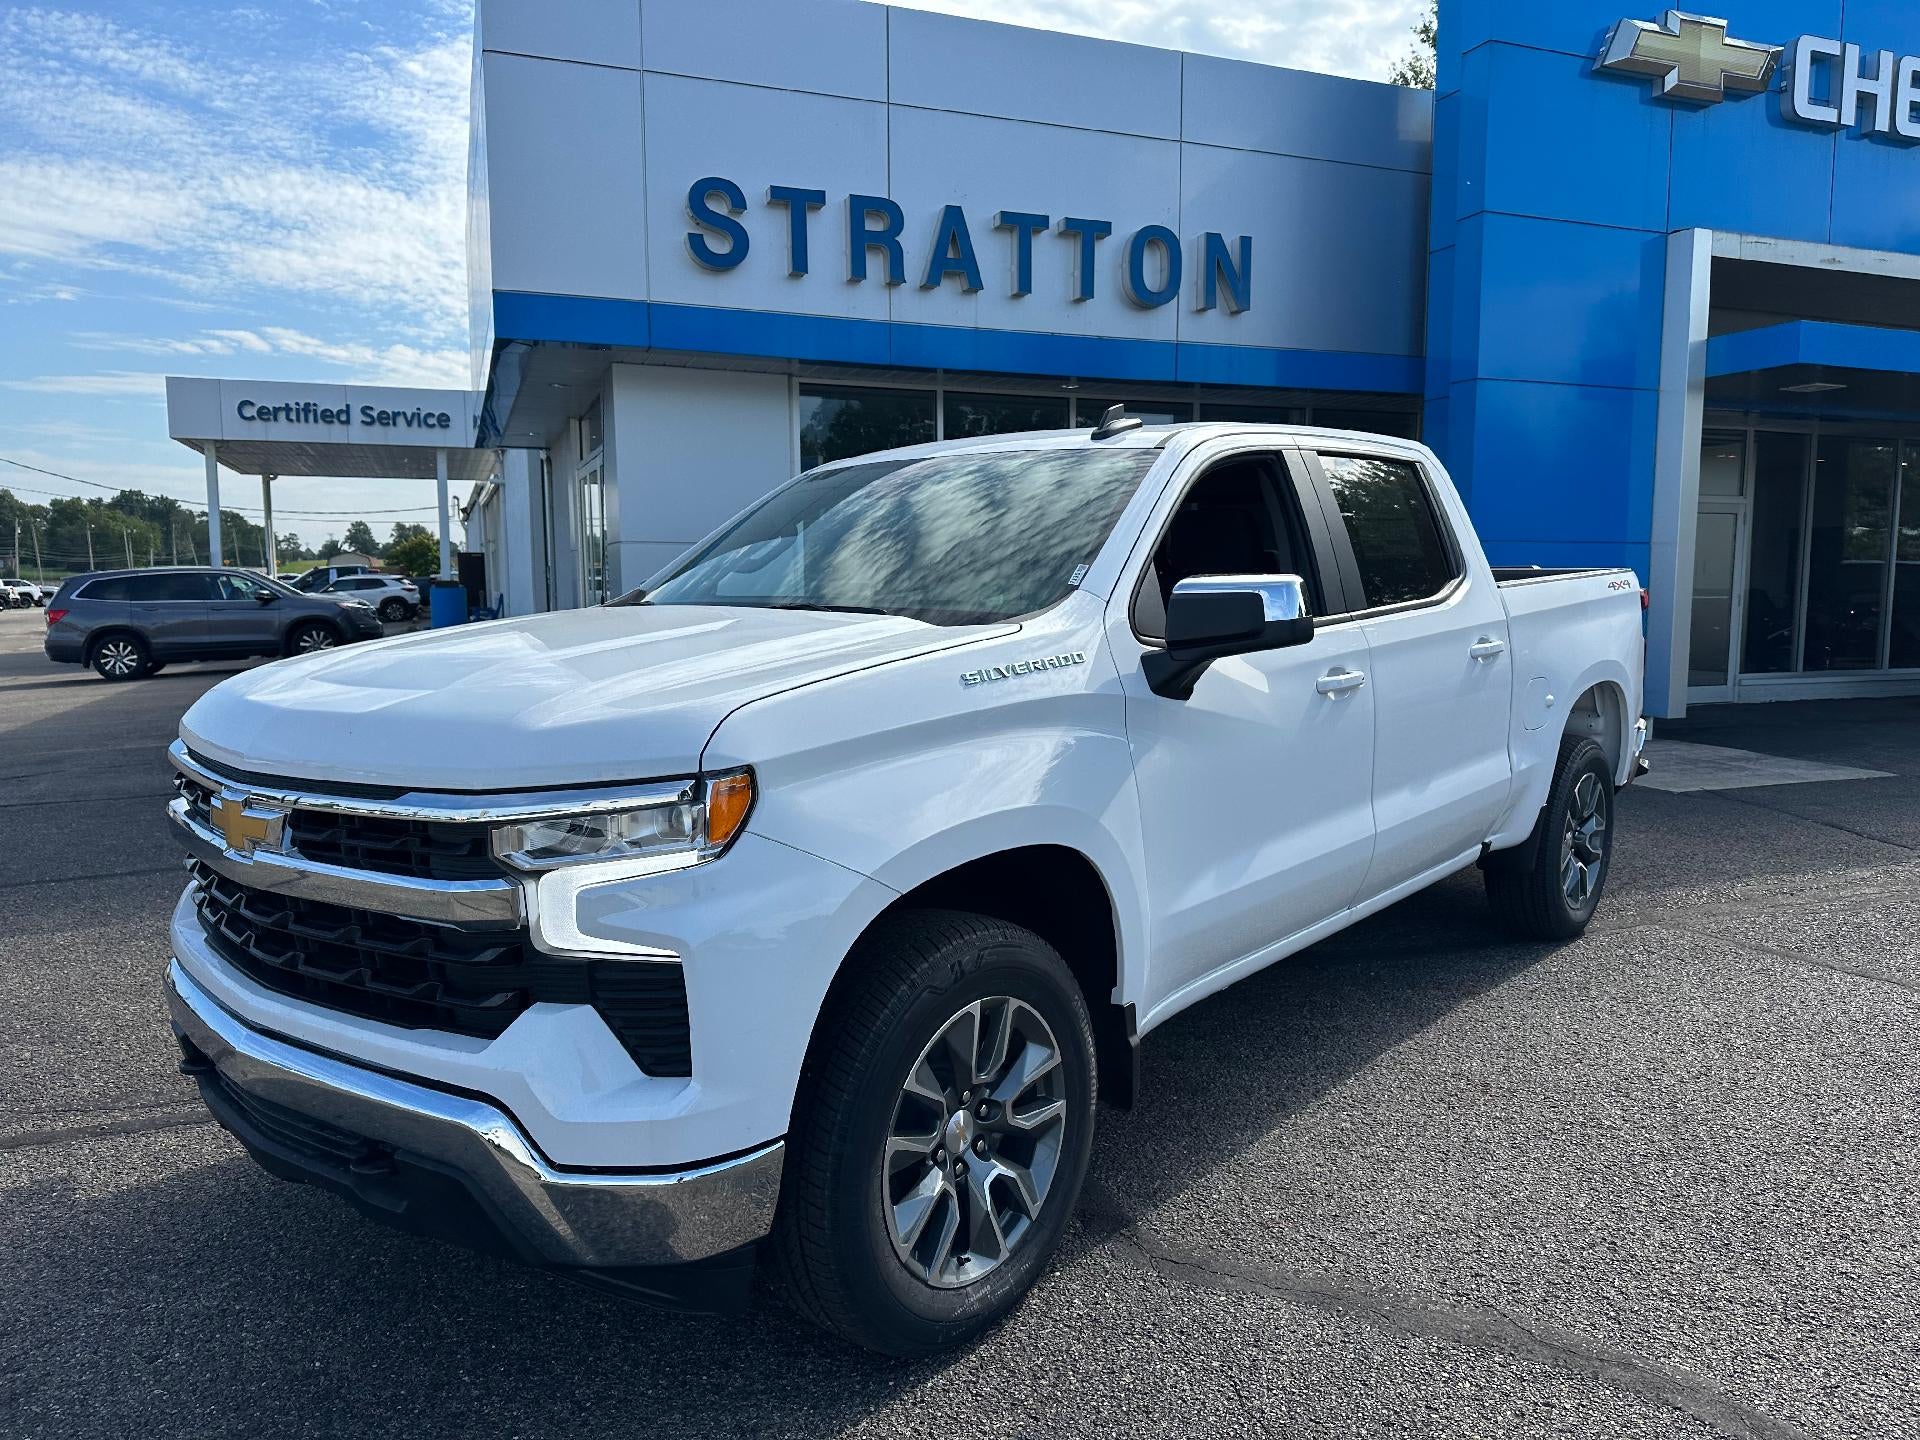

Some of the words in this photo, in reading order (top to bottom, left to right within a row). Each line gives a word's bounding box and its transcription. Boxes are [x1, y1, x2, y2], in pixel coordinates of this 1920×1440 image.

[685, 177, 1253, 314] STRATTON
[236, 399, 351, 426] Certified
[359, 405, 451, 429] Service
[960, 650, 1086, 686] SILVERADO
